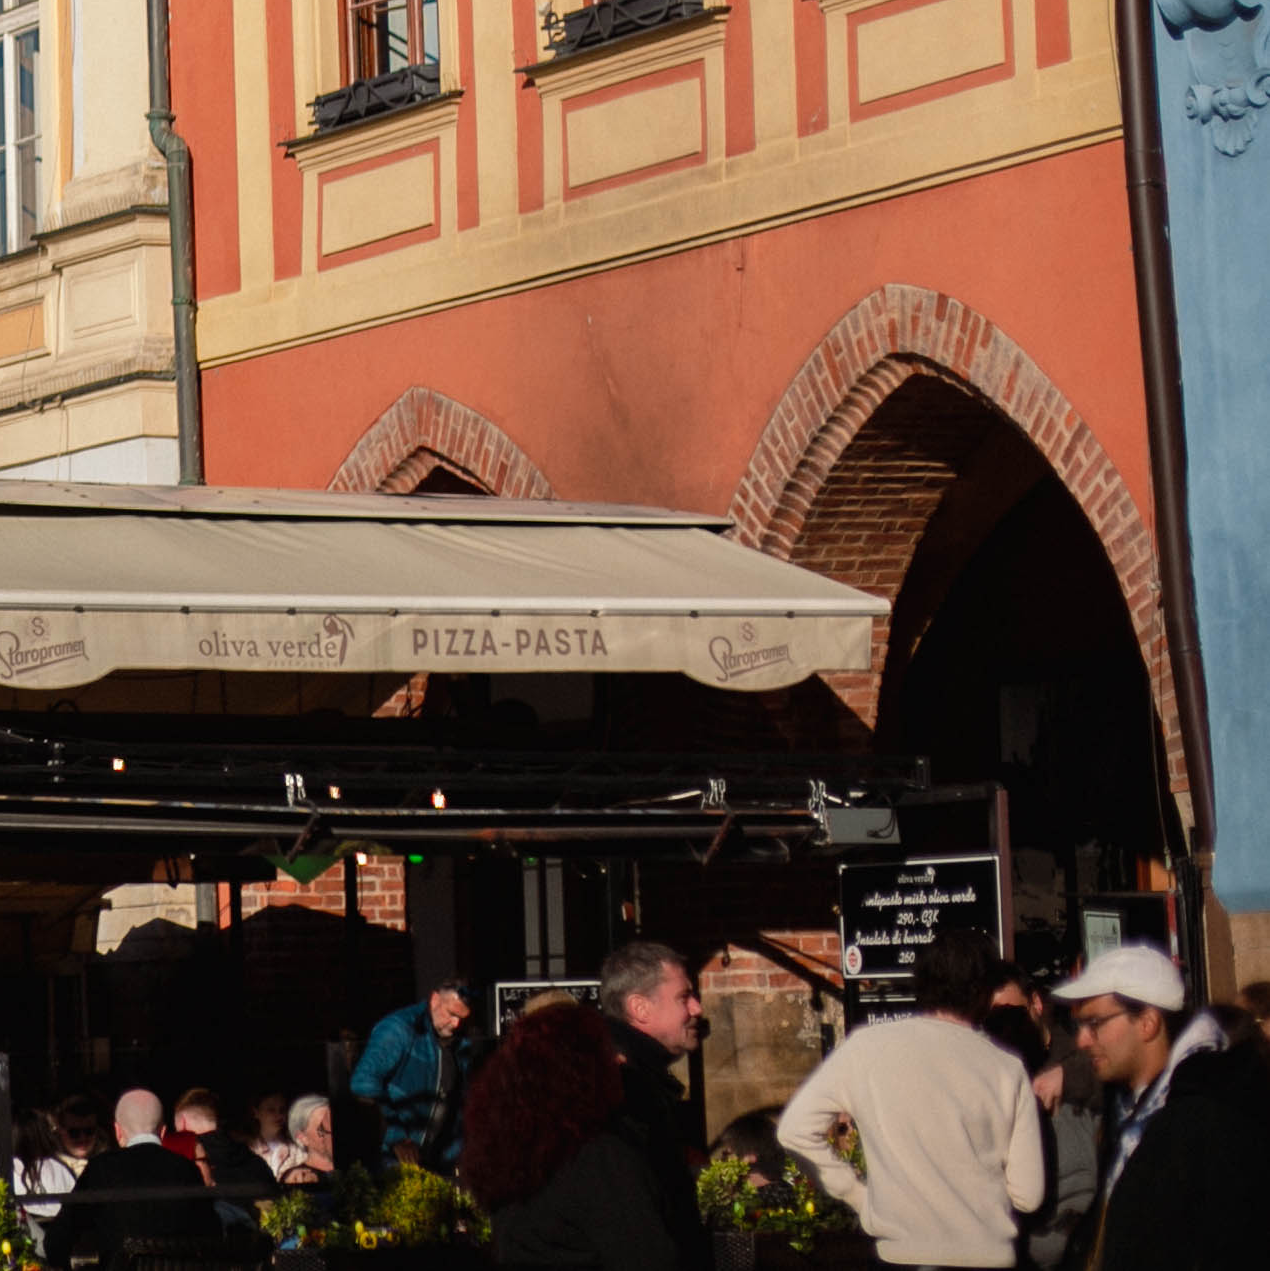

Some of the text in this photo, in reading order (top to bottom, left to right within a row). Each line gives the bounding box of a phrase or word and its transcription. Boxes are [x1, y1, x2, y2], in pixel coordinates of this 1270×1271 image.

[198, 630, 339, 659] oliva verde
[412, 628, 608, 657] PIZZA-PASTA
[708, 635, 794, 683] Staropramen
[861, 891, 903, 912] ntipasto
[928, 888, 950, 903] oliva
[951, 886, 977, 902] verde
